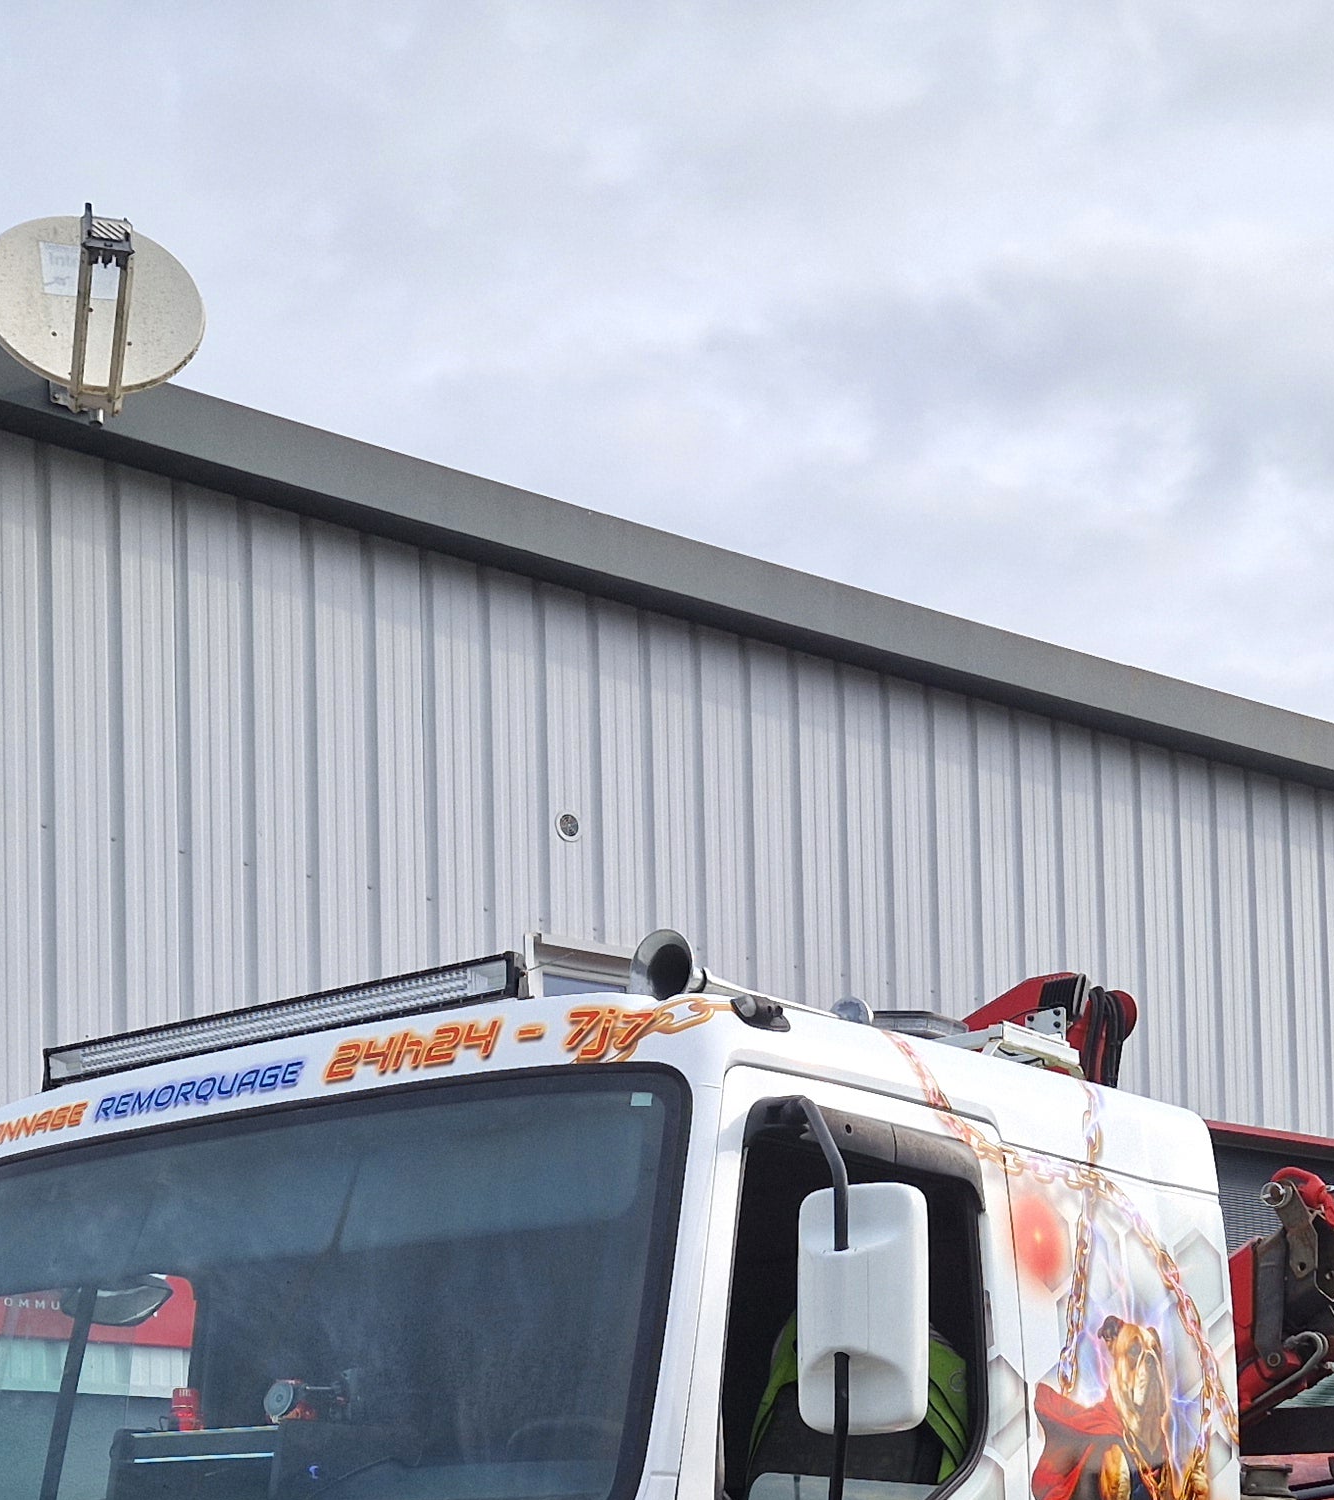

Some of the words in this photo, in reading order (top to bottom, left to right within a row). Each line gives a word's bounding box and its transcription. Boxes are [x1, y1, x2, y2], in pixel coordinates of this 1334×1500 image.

[95, 1061, 305, 1121] REMORQUAGE
[323, 1019, 501, 1081] 24h24
[564, 1008, 655, 1058] 7j7
